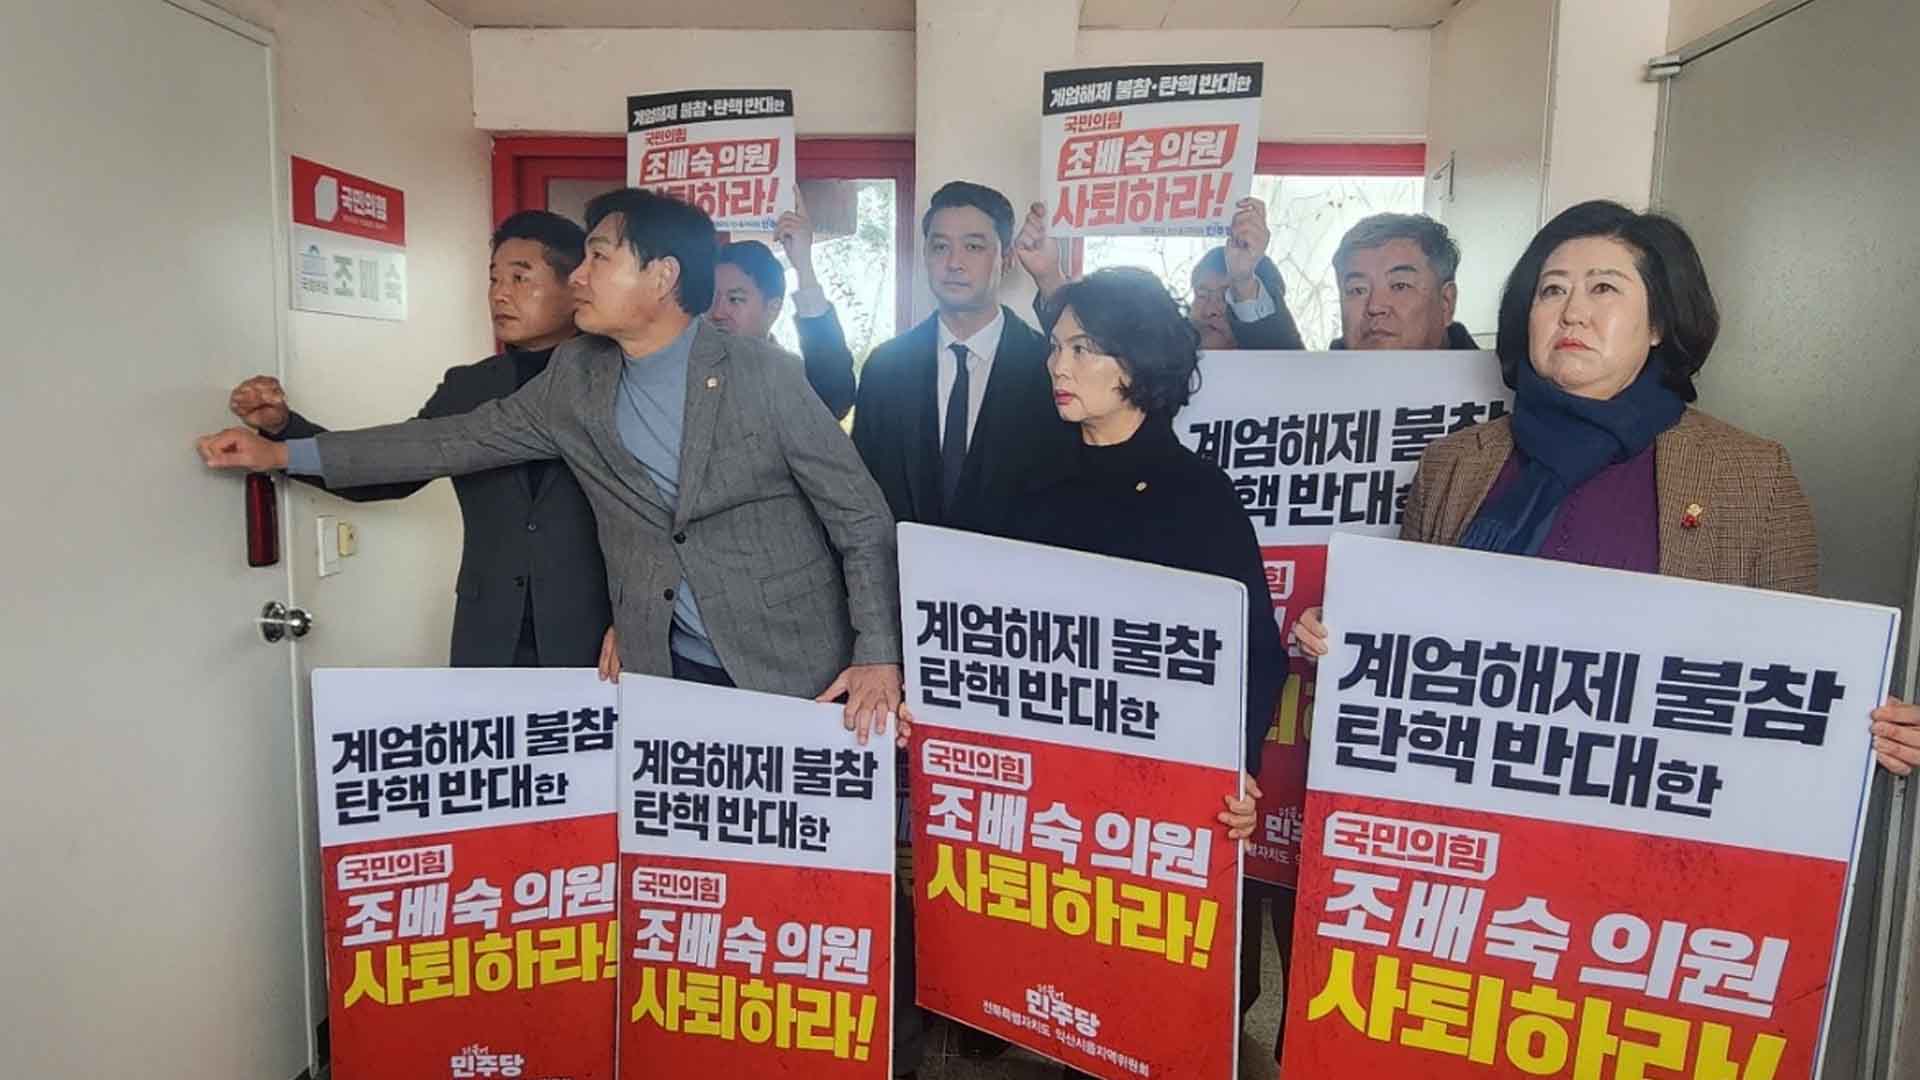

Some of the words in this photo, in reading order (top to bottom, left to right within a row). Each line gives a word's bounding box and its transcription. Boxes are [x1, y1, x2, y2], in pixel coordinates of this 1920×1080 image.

[1050, 80, 1113, 107] 계엄해제
[1199, 72, 1252, 94] 반대한
[644, 128, 687, 146] 국민의힘
[1064, 111, 1123, 133] 국민의힘
[643, 146, 714, 181] 조배숙
[716, 143, 772, 175] 의원
[1064, 135, 1154, 178] 조배숙
[1157, 129, 1228, 169] 의원
[655, 177, 780, 217] 하라!
[1051, 173, 1233, 228] 사퇴하라!
[1190, 409, 1381, 470] 계엄해제
[1235, 474, 1280, 528] 핵
[916, 600, 1100, 671] 계엄해제
[1111, 617, 1223, 686] 불참
[919, 656, 1011, 719] 탄핵
[1018, 668, 1160, 741] 반대한
[1337, 631, 1641, 725] 계엄해제
[1652, 653, 1847, 747] 불참
[331, 715, 515, 775] 계엄해제
[525, 706, 618, 757] 불참
[632, 739, 783, 794] 계엄해제
[792, 745, 879, 800] 불참
[927, 743, 1026, 786] 국민의힘
[1334, 703, 1482, 785] 탄핵
[1490, 719, 1724, 819] 반대한
[334, 772, 430, 827] 탄핵
[438, 763, 569, 817] 반대한
[633, 790, 710, 841] 탄핵
[716, 797, 831, 853] 반대한
[343, 849, 446, 881] 국민의힘
[925, 783, 1083, 866] 조배숙
[1090, 812, 1213, 889] 의원
[1332, 815, 1489, 875] 국민의힘
[341, 877, 503, 948] 조배숙
[510, 861, 617, 925] 의원
[637, 870, 721, 902] 국민의힘
[926, 843, 1219, 969] 사퇴하라!
[632, 908, 767, 975] 조배숙
[773, 921, 873, 985] 의원
[1316, 869, 1570, 981] 조배숙
[1577, 912, 1791, 1020] 의원
[632, 966, 878, 1062] 사퇴하라!
[1025, 987, 1101, 1038] 민주당
[450, 1053, 526, 1078] 민주당
